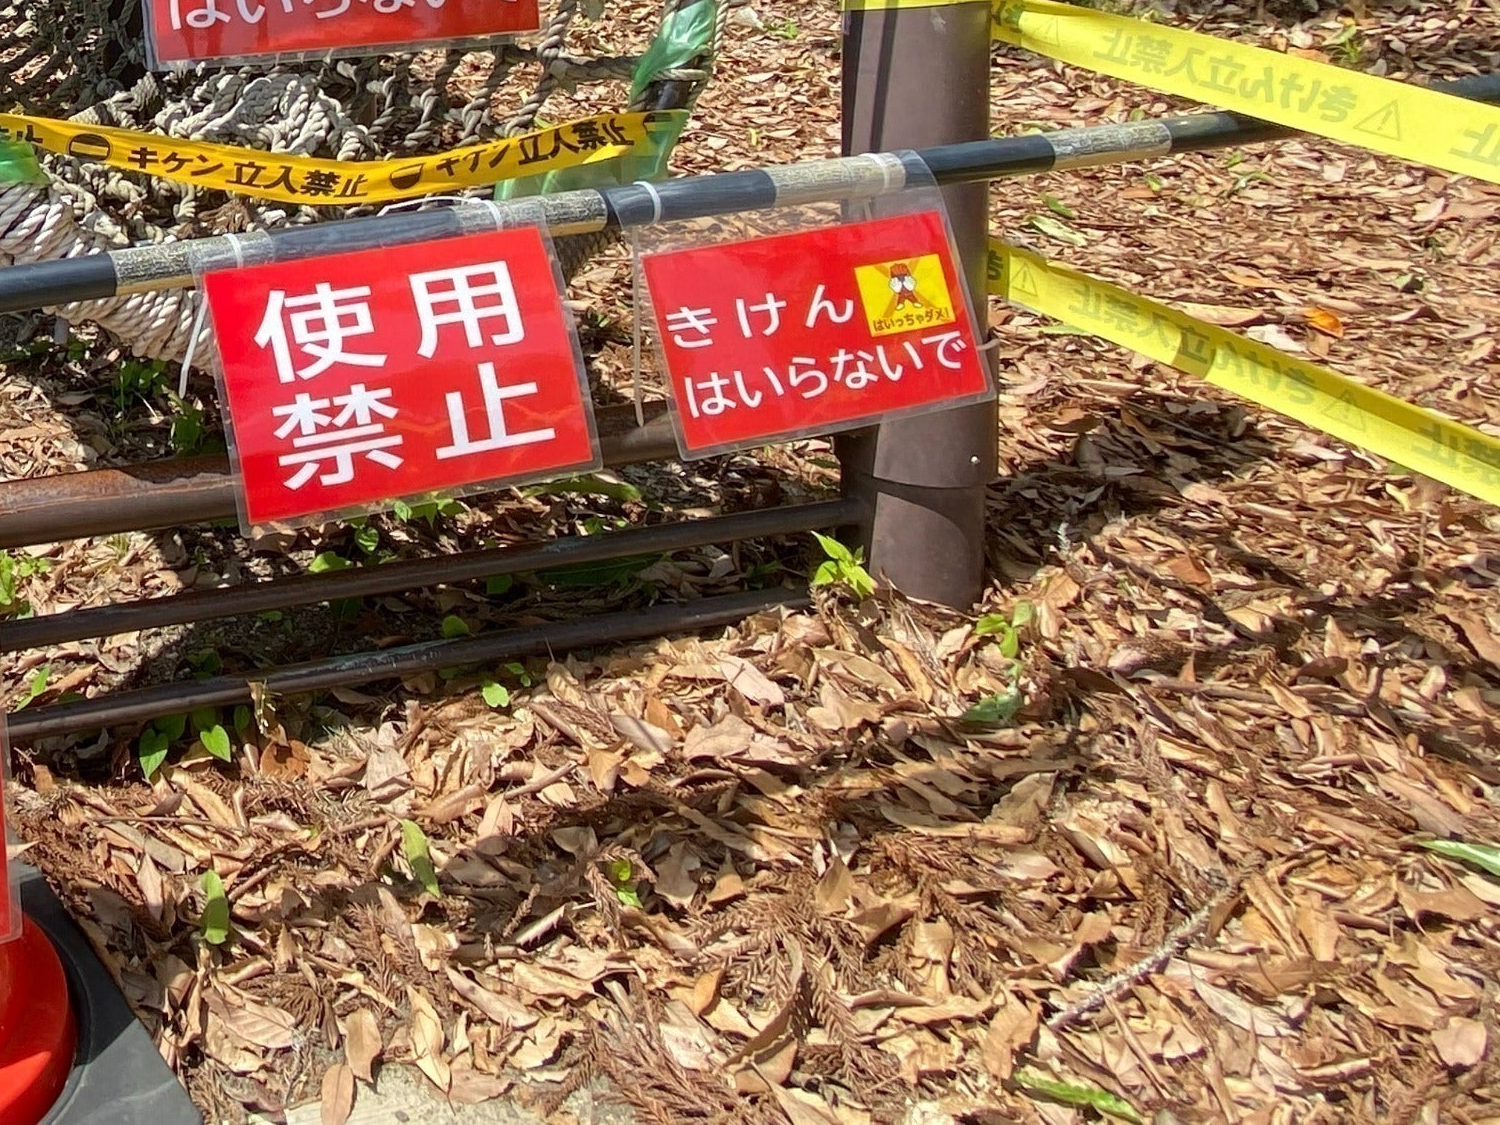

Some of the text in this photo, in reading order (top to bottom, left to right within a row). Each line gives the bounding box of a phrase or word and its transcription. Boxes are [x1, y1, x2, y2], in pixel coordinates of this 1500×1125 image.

[254, 260, 526, 384] 使用
[665, 284, 855, 349] きけん
[272, 362, 556, 492] 禁止
[684, 330, 968, 419] はいらないで
